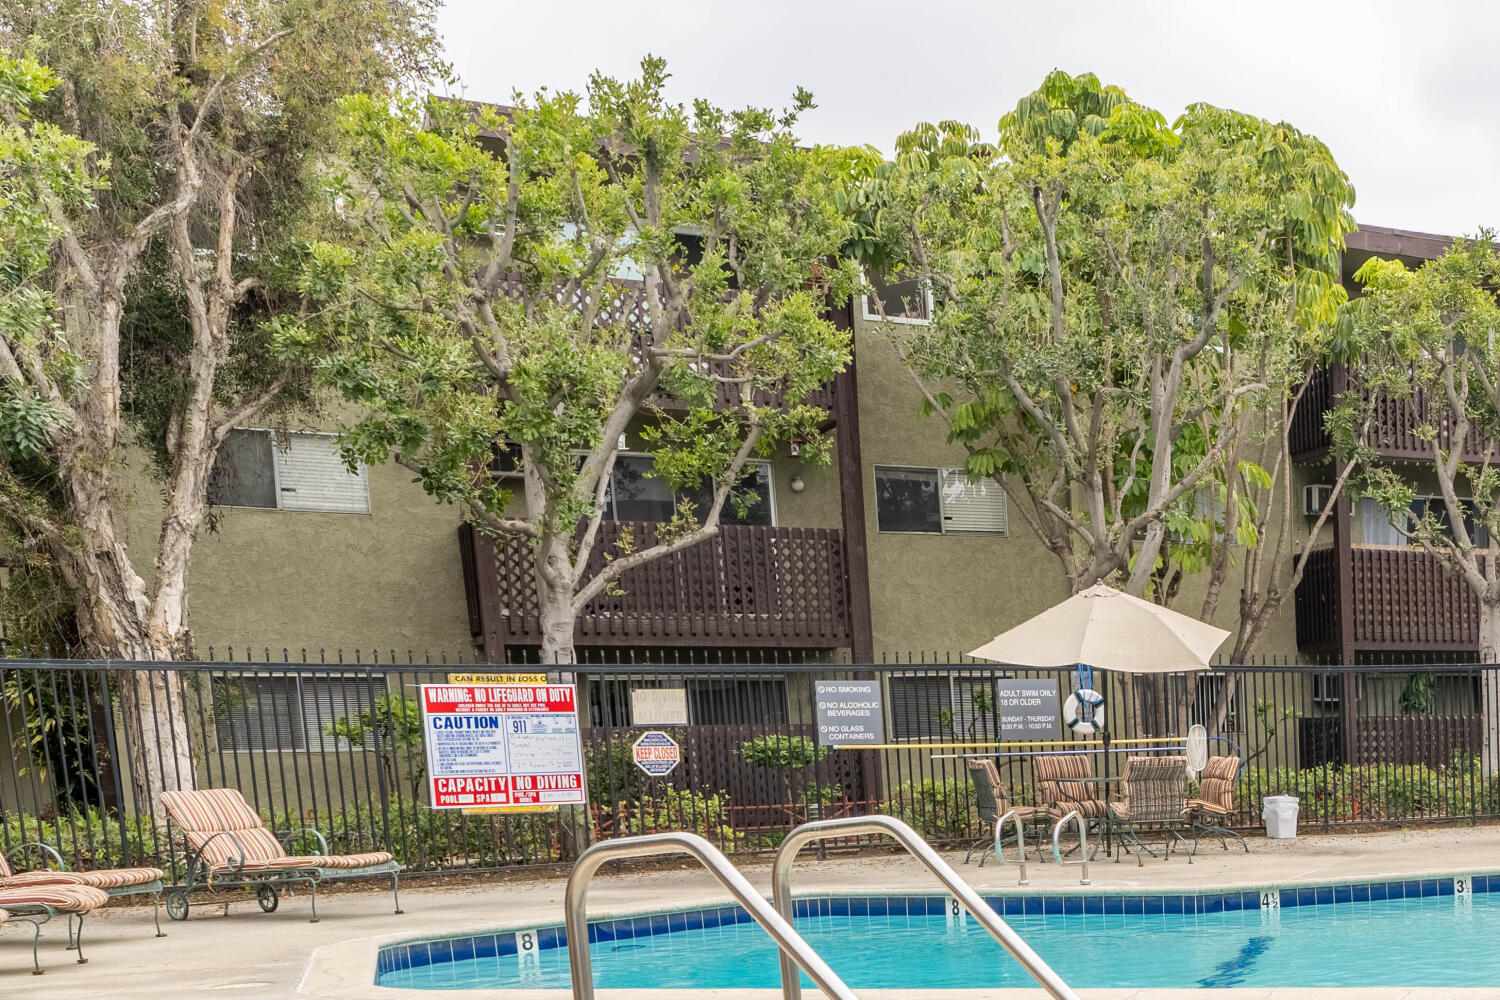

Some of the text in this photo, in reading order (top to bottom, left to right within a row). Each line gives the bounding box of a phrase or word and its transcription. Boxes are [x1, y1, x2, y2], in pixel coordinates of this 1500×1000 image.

[428, 687, 571, 703] WARNING: NO LIFEGUARD ON DUTY
[1019, 698, 1042, 706] OLDER
[839, 701, 879, 709] ALCOHOLIC
[432, 716, 499, 730] CAUTION
[513, 720, 527, 733] 911
[635, 747, 678, 760] KEEP CLOSED
[437, 776, 506, 793] CAPACITY
[516, 775, 577, 790] NO DIVING
[440, 794, 458, 804] POOL
[476, 793, 491, 803] SPA
[952, 898, 960, 916] 8
[521, 933, 533, 951] 8
